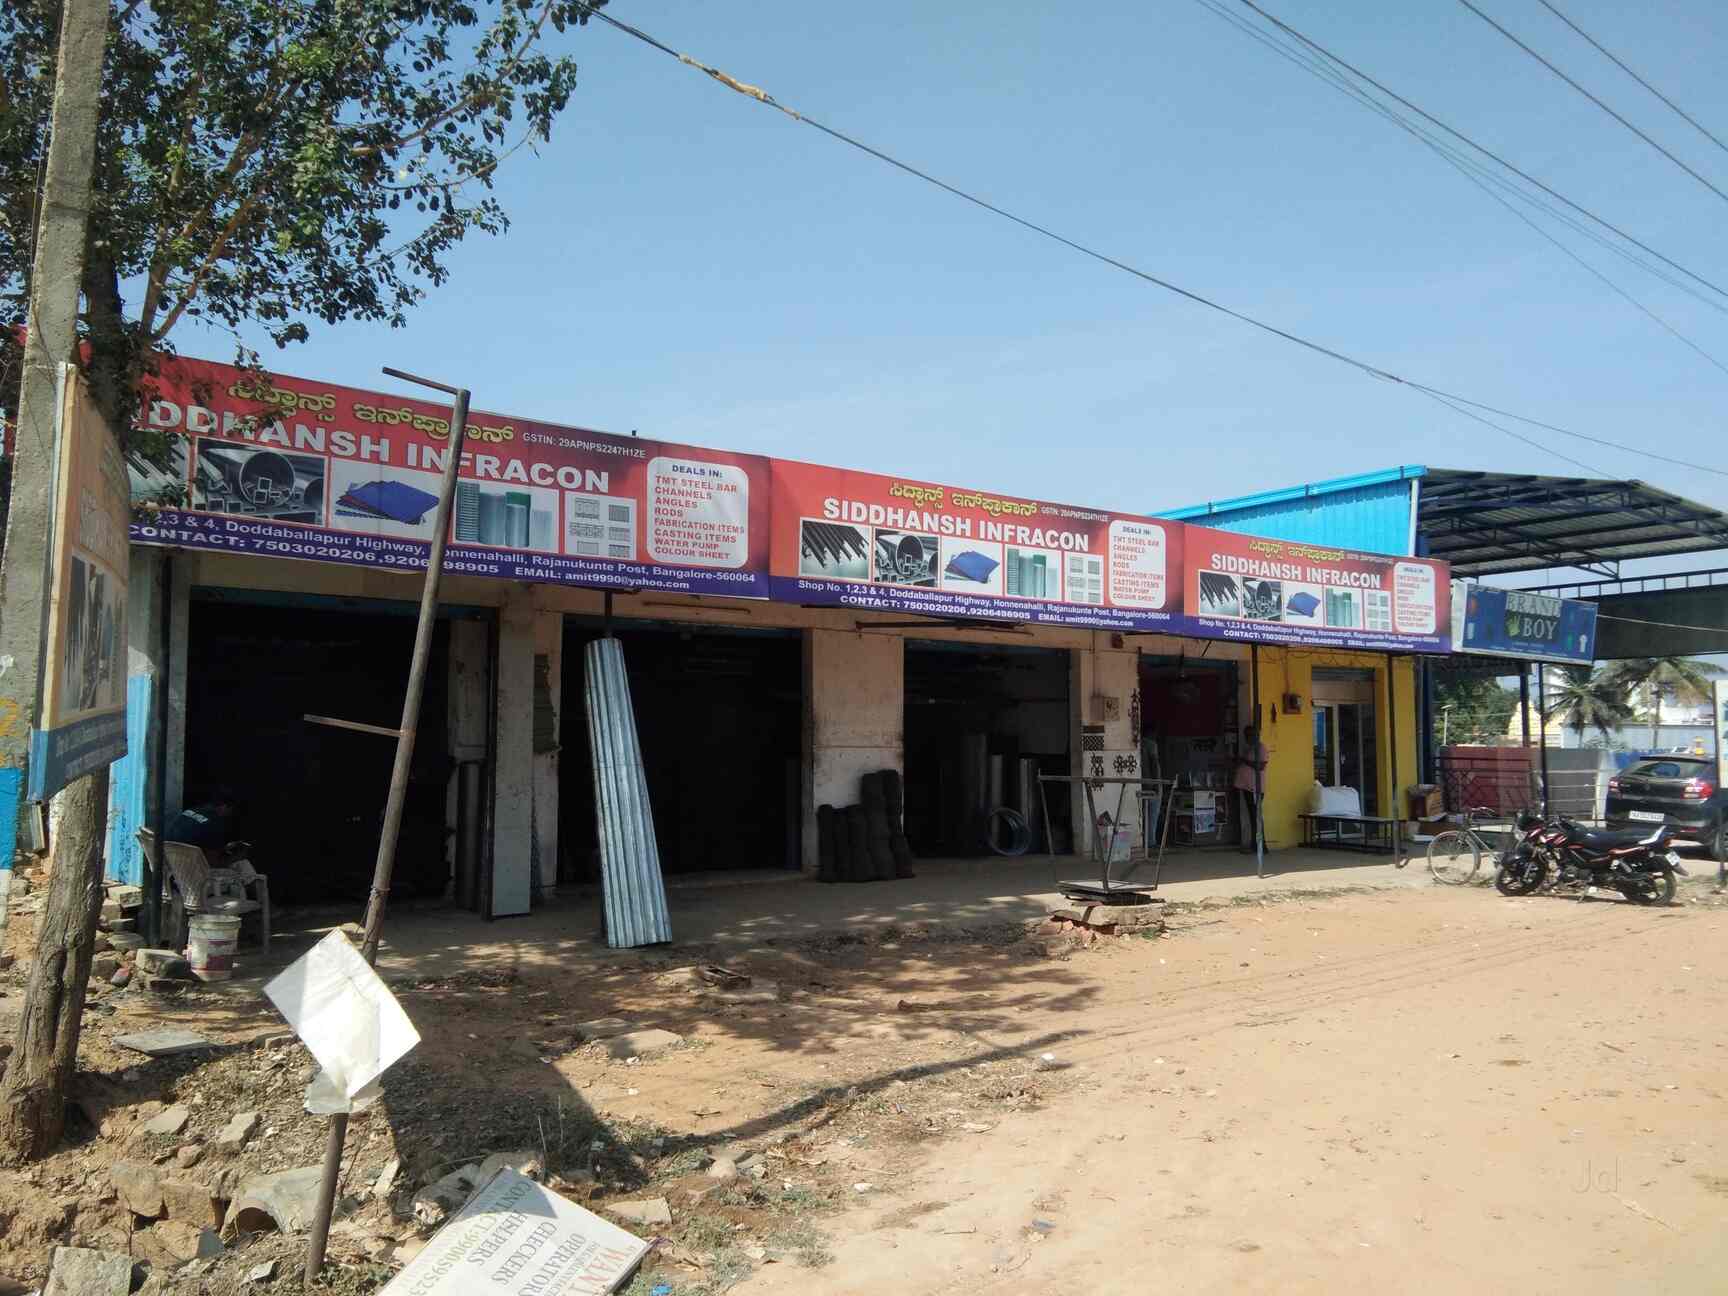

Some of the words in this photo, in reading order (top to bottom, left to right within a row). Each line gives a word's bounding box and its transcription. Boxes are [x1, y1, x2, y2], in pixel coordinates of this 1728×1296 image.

[133, 399, 390, 462] DDHANSH
[407, 442, 609, 493] INFRACON
[522, 432, 556, 446] GSTIN:
[672, 464, 706, 477] DEALS
[708, 469, 723, 479] IN:
[655, 475, 677, 486] TMT
[680, 478, 714, 491] STEEL
[715, 484, 737, 493] BAR
[655, 486, 712, 501] CHANNELS
[655, 497, 698, 509] ANGLES
[654, 507, 684, 518] RODS
[654, 517, 715, 531] FABRICATION
[718, 525, 745, 534] ITEMS
[823, 497, 971, 537] SIDDHANSH
[979, 520, 1089, 552] INFRACON
[654, 528, 702, 541] CASTING
[705, 534, 737, 544] ITEMS
[654, 538, 689, 549] WATER
[692, 542, 720, 551] PUMP
[129, 524, 245, 546] CONTACT:
[515, 566, 562, 580] EMAIL:
[565, 572, 690, 589] amit9990@yahoo.com
[185, 515, 200, 528] &
[225, 520, 352, 547] Doddaballapur
[355, 537, 426, 556] Highway,
[532, 555, 614, 573] Rajanukunte
[618, 564, 649, 576] Post,
[653, 566, 755, 583] Bangalore-560064
[654, 547, 696, 558] COLOUR
[699, 551, 731, 560] SHEET
[1211, 553, 1302, 580] SIDDHANSH
[1306, 566, 1381, 588] INFRACON
[798, 580, 824, 592] Shop
[827, 583, 842, 592] No.
[869, 586, 877, 595] &
[955, 595, 991, 607] Highway,
[840, 595, 900, 608] CONTACT:
[1523, 617, 1557, 640] BOY
[466, 1211, 529, 1266] HELPERS
[491, 1220, 558, 1286] CHECKERS
